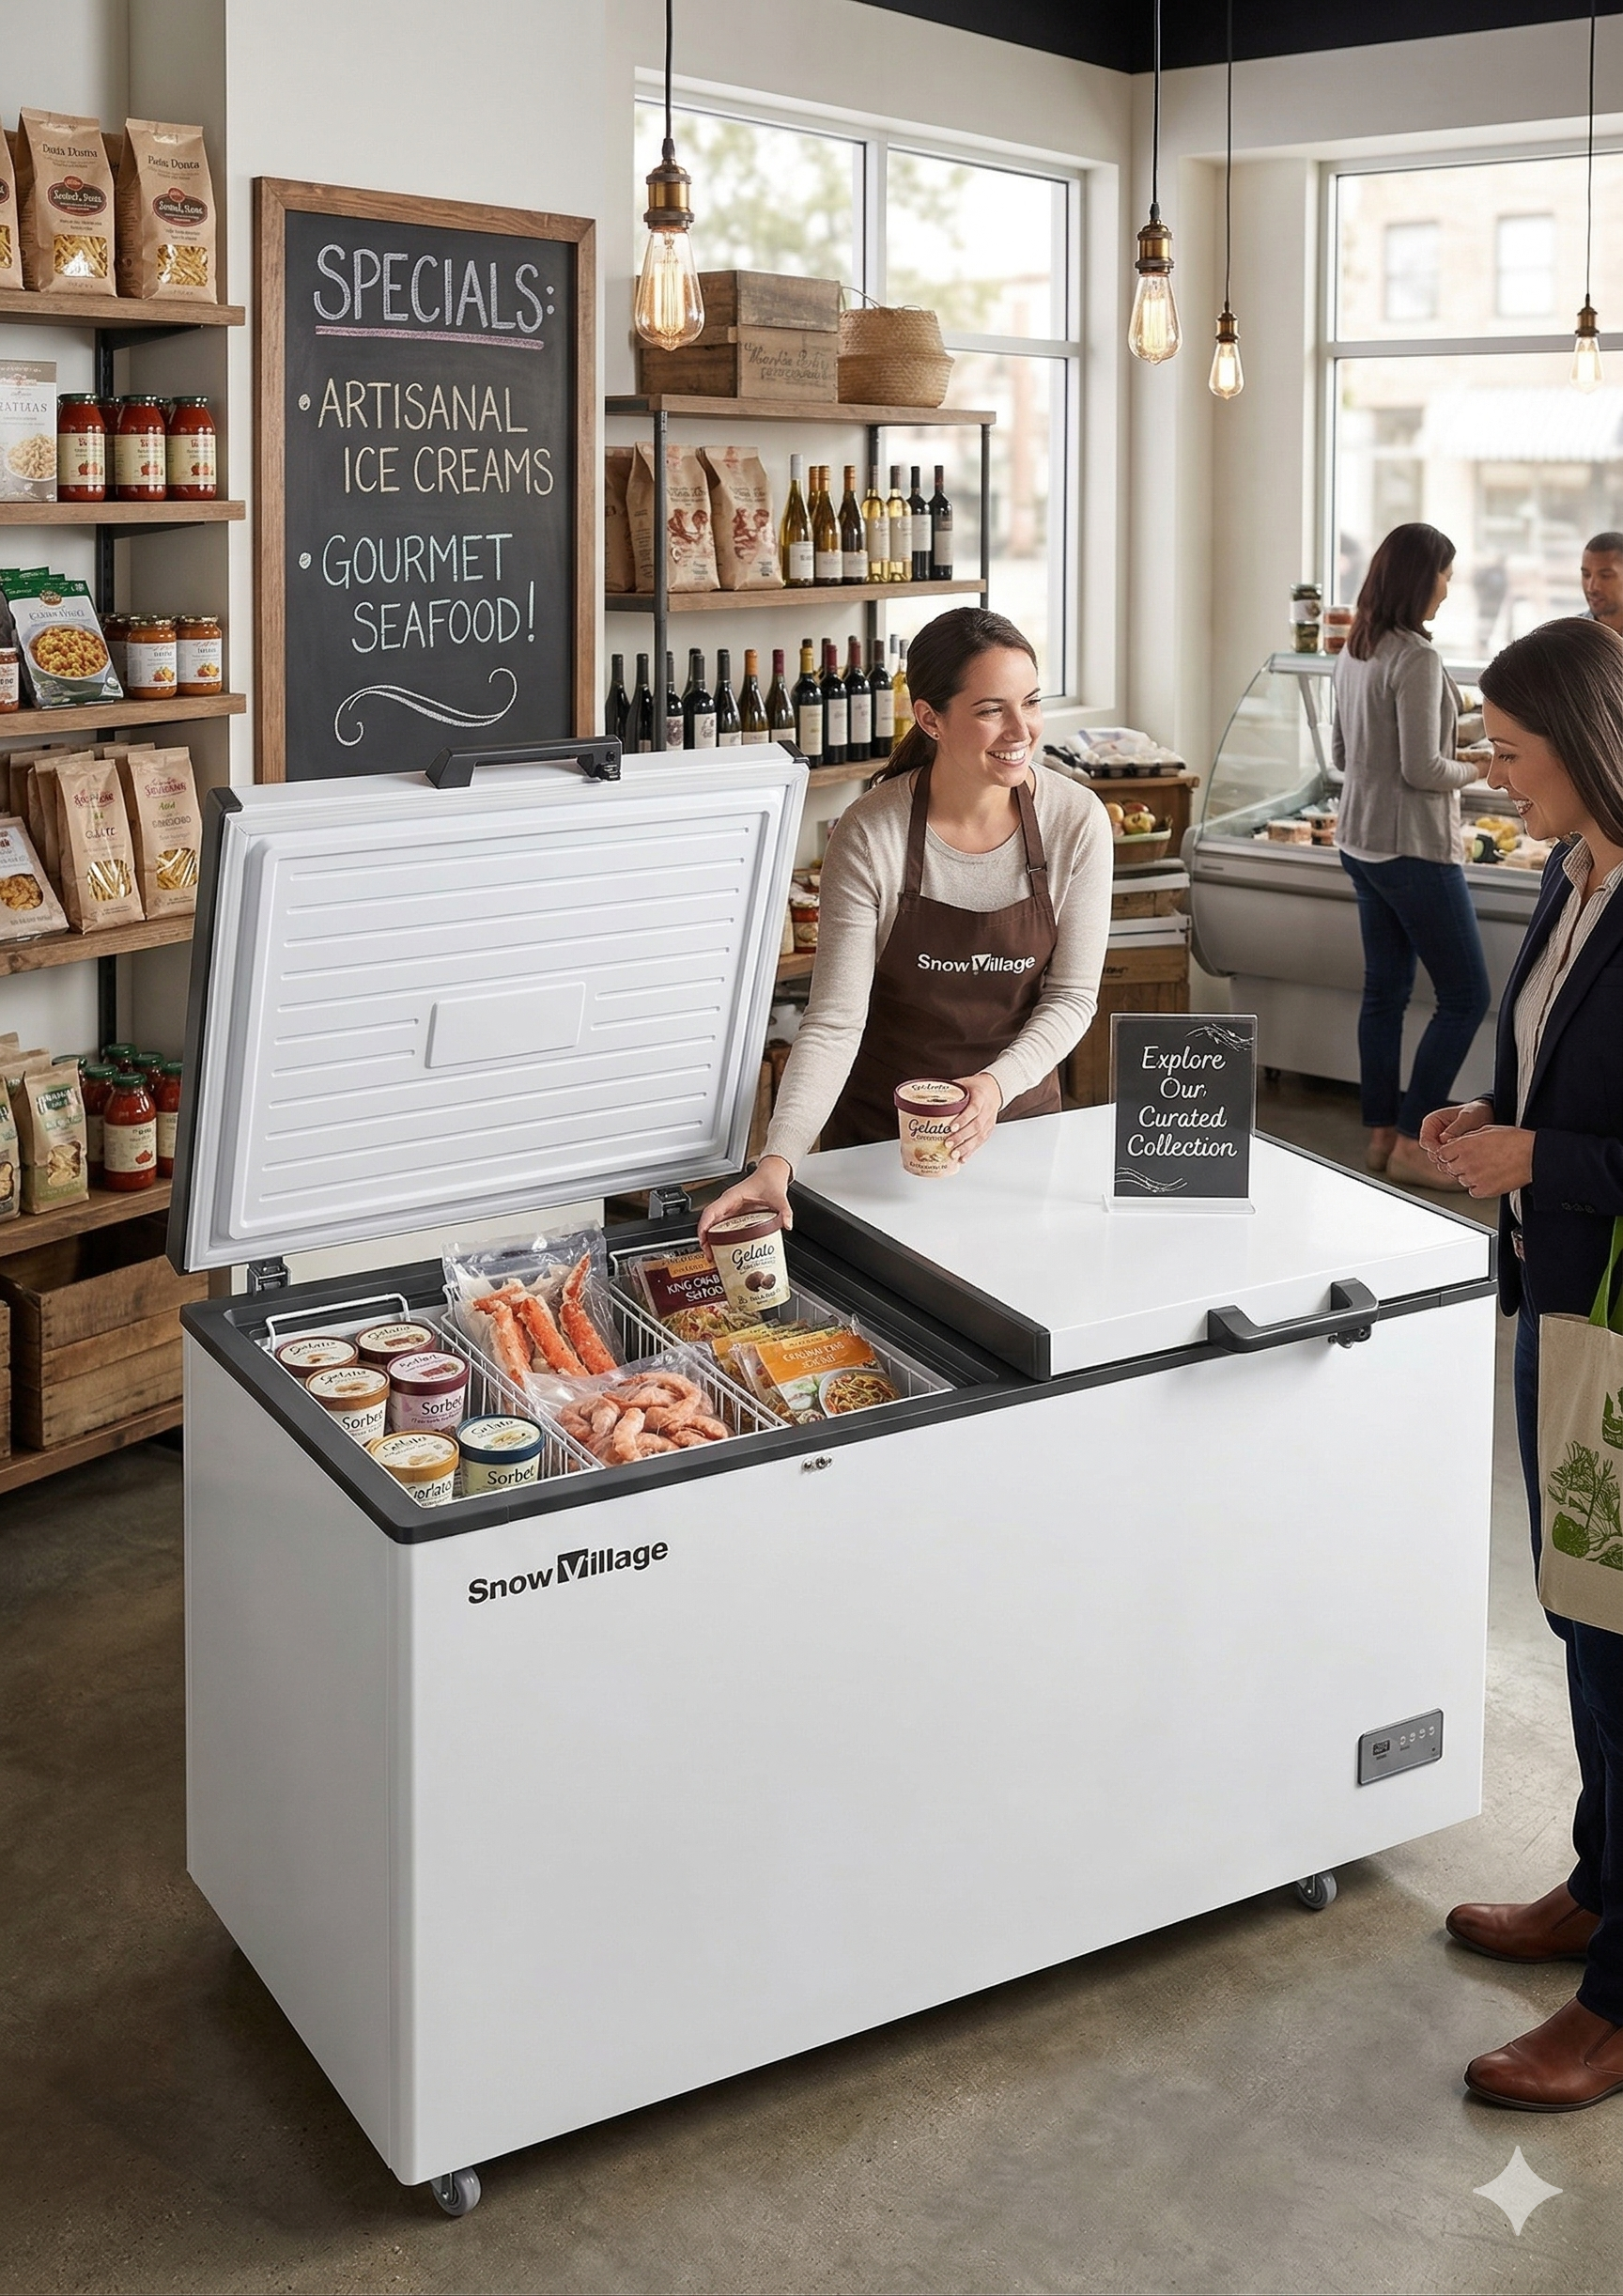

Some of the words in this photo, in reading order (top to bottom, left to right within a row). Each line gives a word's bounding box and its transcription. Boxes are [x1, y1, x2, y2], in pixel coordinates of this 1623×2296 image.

[313, 243, 555, 334] SPECIALS:
[317, 378, 529, 433] ARTISANAL
[343, 446, 400, 493] ICE
[413, 446, 554, 495] CREAMS
[322, 533, 514, 590] GOURMET
[350, 581, 535, 653] SEAFOOD!
[1141, 1046, 1227, 1077] Explore
[1138, 1105, 1228, 1127] Curated
[1127, 1133, 1238, 1157] Collection
[732, 1243, 775, 1271] Gelato
[422, 1395, 462, 1416] Sorbet
[487, 1465, 534, 1485] Sorbet
